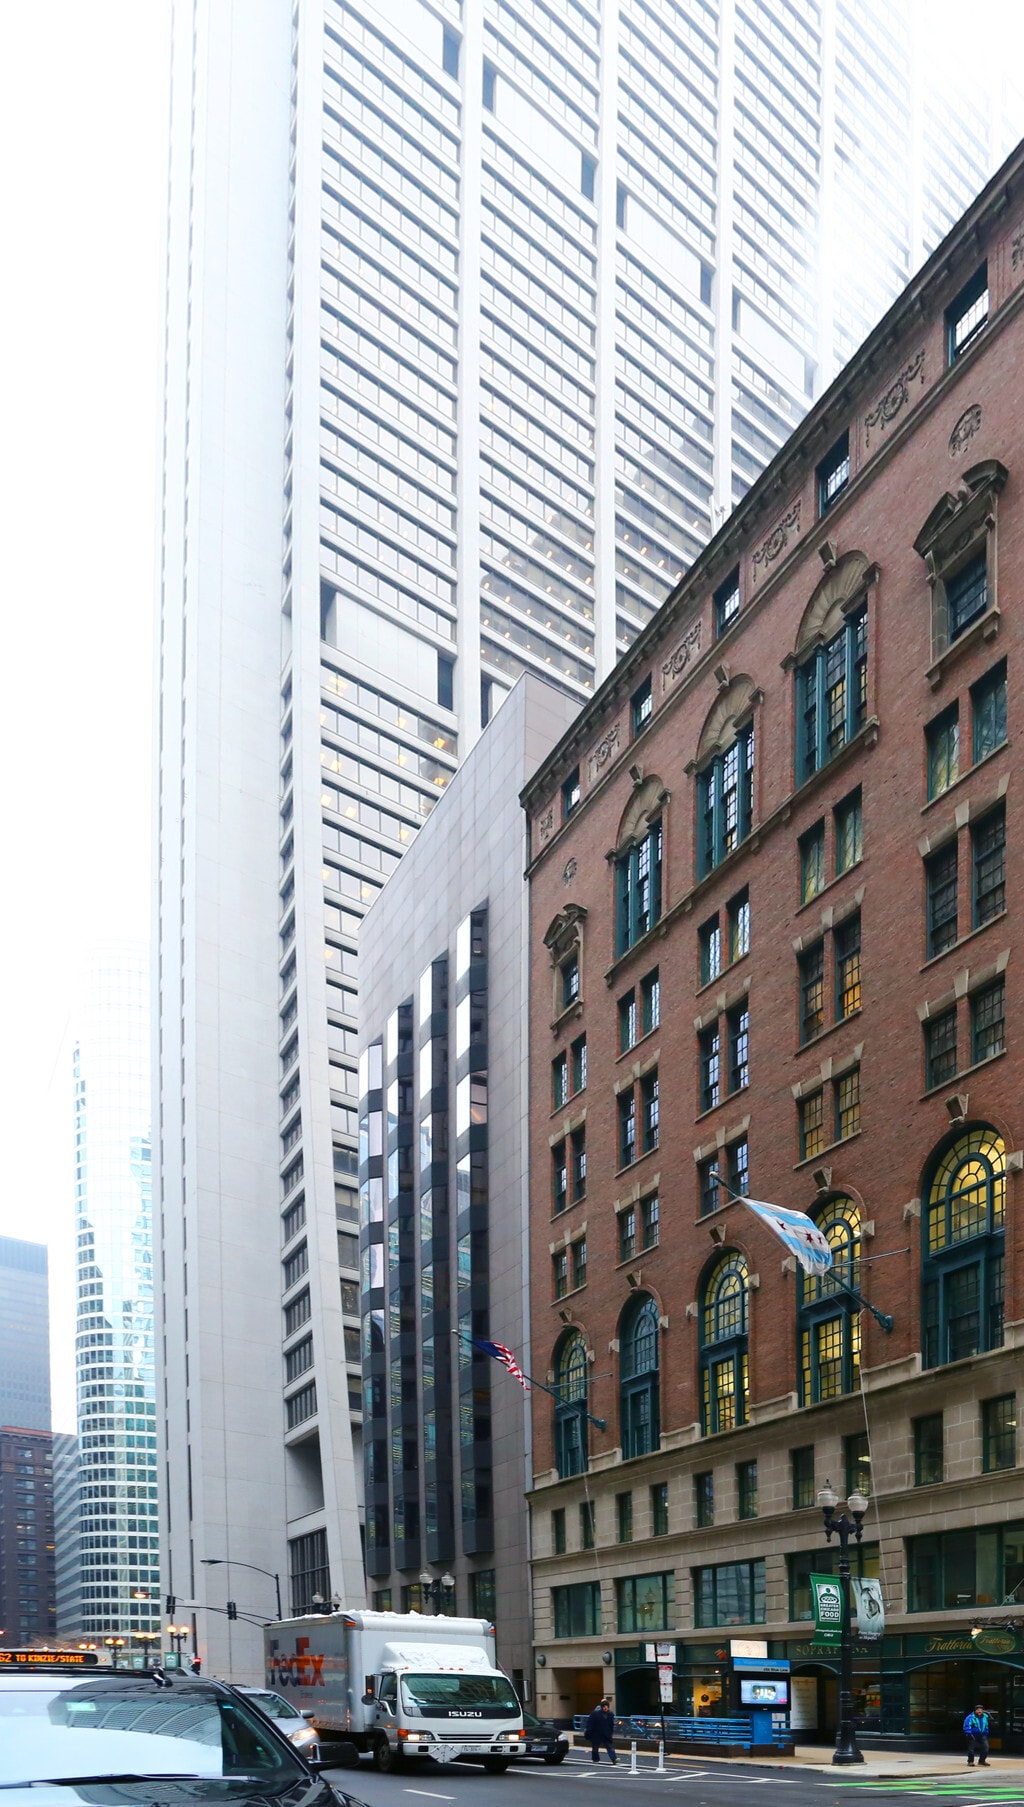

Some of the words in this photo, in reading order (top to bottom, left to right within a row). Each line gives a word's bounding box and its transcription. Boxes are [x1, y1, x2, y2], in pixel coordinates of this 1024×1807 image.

[925, 1637, 973, 1652] Trattoria
[16, 1654, 26, 1662] TO
[28, 1654, 84, 1663] KINZIE/STATE
[269, 1637, 325, 1687] FedEx
